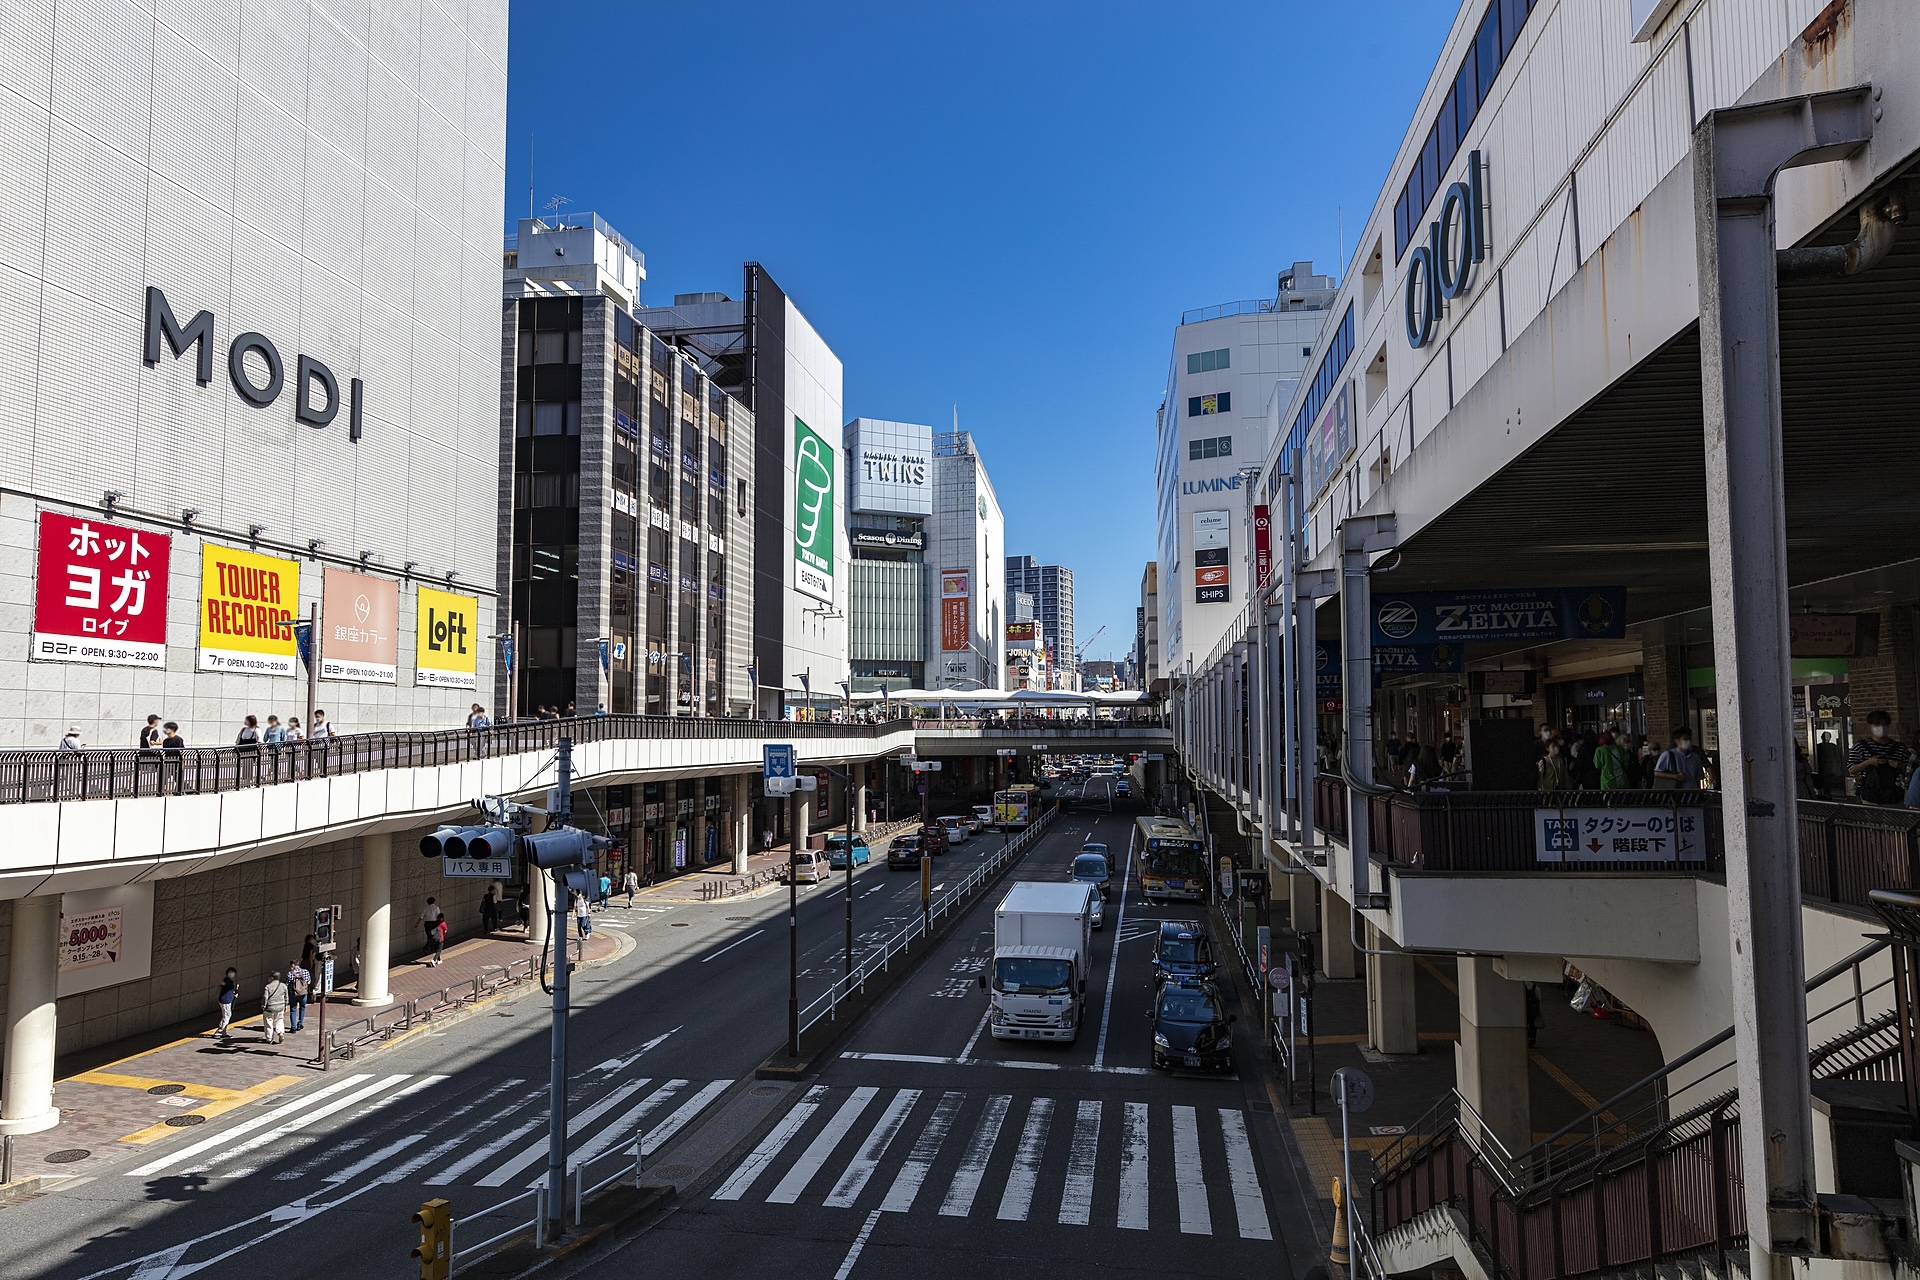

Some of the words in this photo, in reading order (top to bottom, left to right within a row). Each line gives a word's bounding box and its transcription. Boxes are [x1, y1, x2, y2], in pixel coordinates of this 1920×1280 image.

[143, 286, 363, 443] MODI
[864, 461, 925, 485] TWINS
[1183, 477, 1240, 496] LUMINE
[68, 523, 150, 565] ホット
[858, 533, 885, 543] Season
[897, 537, 922, 546] Dining
[216, 561, 280, 605] TOWER
[802, 570, 812, 585] EAST
[65, 564, 151, 616] ヨガ
[1201, 590, 1224, 599] SHIPS
[1469, 603, 1486, 612] FC
[1490, 601, 1555, 611] MACHIDA
[82, 617, 129, 635] ロイブ
[208, 598, 292, 641] RECORDS
[1435, 605, 1558, 631] ZELVIA
[334, 624, 388, 645] 銀座カラー
[41, 641, 77, 655] B2F
[1009, 648, 1032, 656] JORNA
[208, 654, 225, 666] 7F
[324, 664, 345, 674] B2F
[1546, 820, 1575, 829] TAXI
[1585, 816, 1695, 833] タクシーのりば
[1612, 838, 1667, 852] 階段下
[452, 862, 503, 873] バス専用
[69, 924, 108, 946] 5,000
[67, 942, 108, 955] クーポンプレゼント
